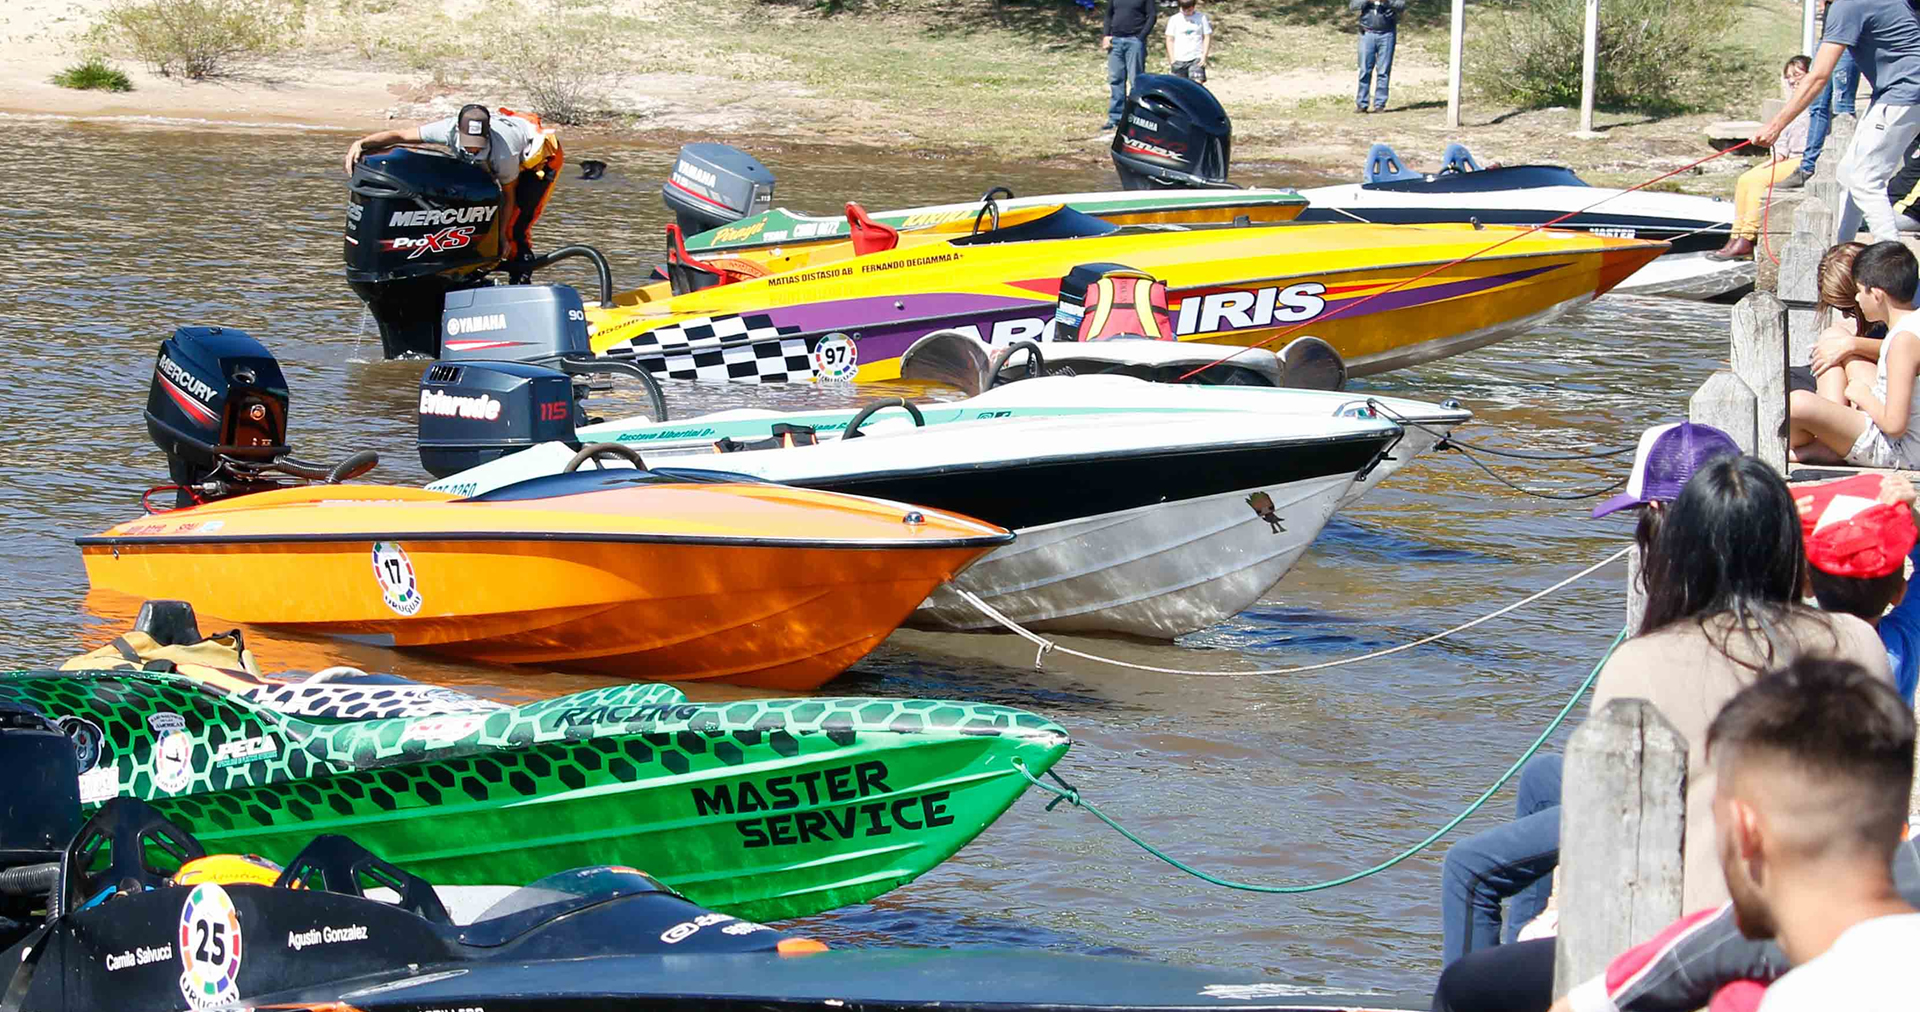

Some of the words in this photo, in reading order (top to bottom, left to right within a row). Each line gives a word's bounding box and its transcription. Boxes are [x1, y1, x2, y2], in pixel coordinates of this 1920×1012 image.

[1132, 115, 1158, 132] YAMAHA
[678, 159, 716, 188] YAMAHA
[388, 205, 498, 227] MERCURY
[768, 276, 800, 287] MATIAS
[801, 269, 840, 282] DISTASIO
[841, 267, 853, 276] AB
[861, 260, 904, 273] FERNANDO
[568, 310, 584, 321] 90
[1176, 282, 1326, 336] IRIS
[459, 313, 507, 332] YAMAHA
[825, 346, 846, 365] 97
[158, 354, 218, 403] MERCURY
[419, 389, 501, 421] Evinrude
[540, 402, 566, 421] 115
[616, 432, 657, 442] Gustavo
[657, 428, 701, 439] Albertini
[384, 559, 401, 584] 17
[552, 702, 701, 728] RACING
[215, 735, 278, 762] PECA
[690, 760, 893, 816] MASTER
[736, 791, 955, 848] SERVICE
[195, 918, 226, 966] 25
[288, 928, 321, 950] Agustin
[322, 924, 368, 944] Gonzalez
[106, 951, 135, 971] Camila
[136, 942, 173, 964] Salvucci
